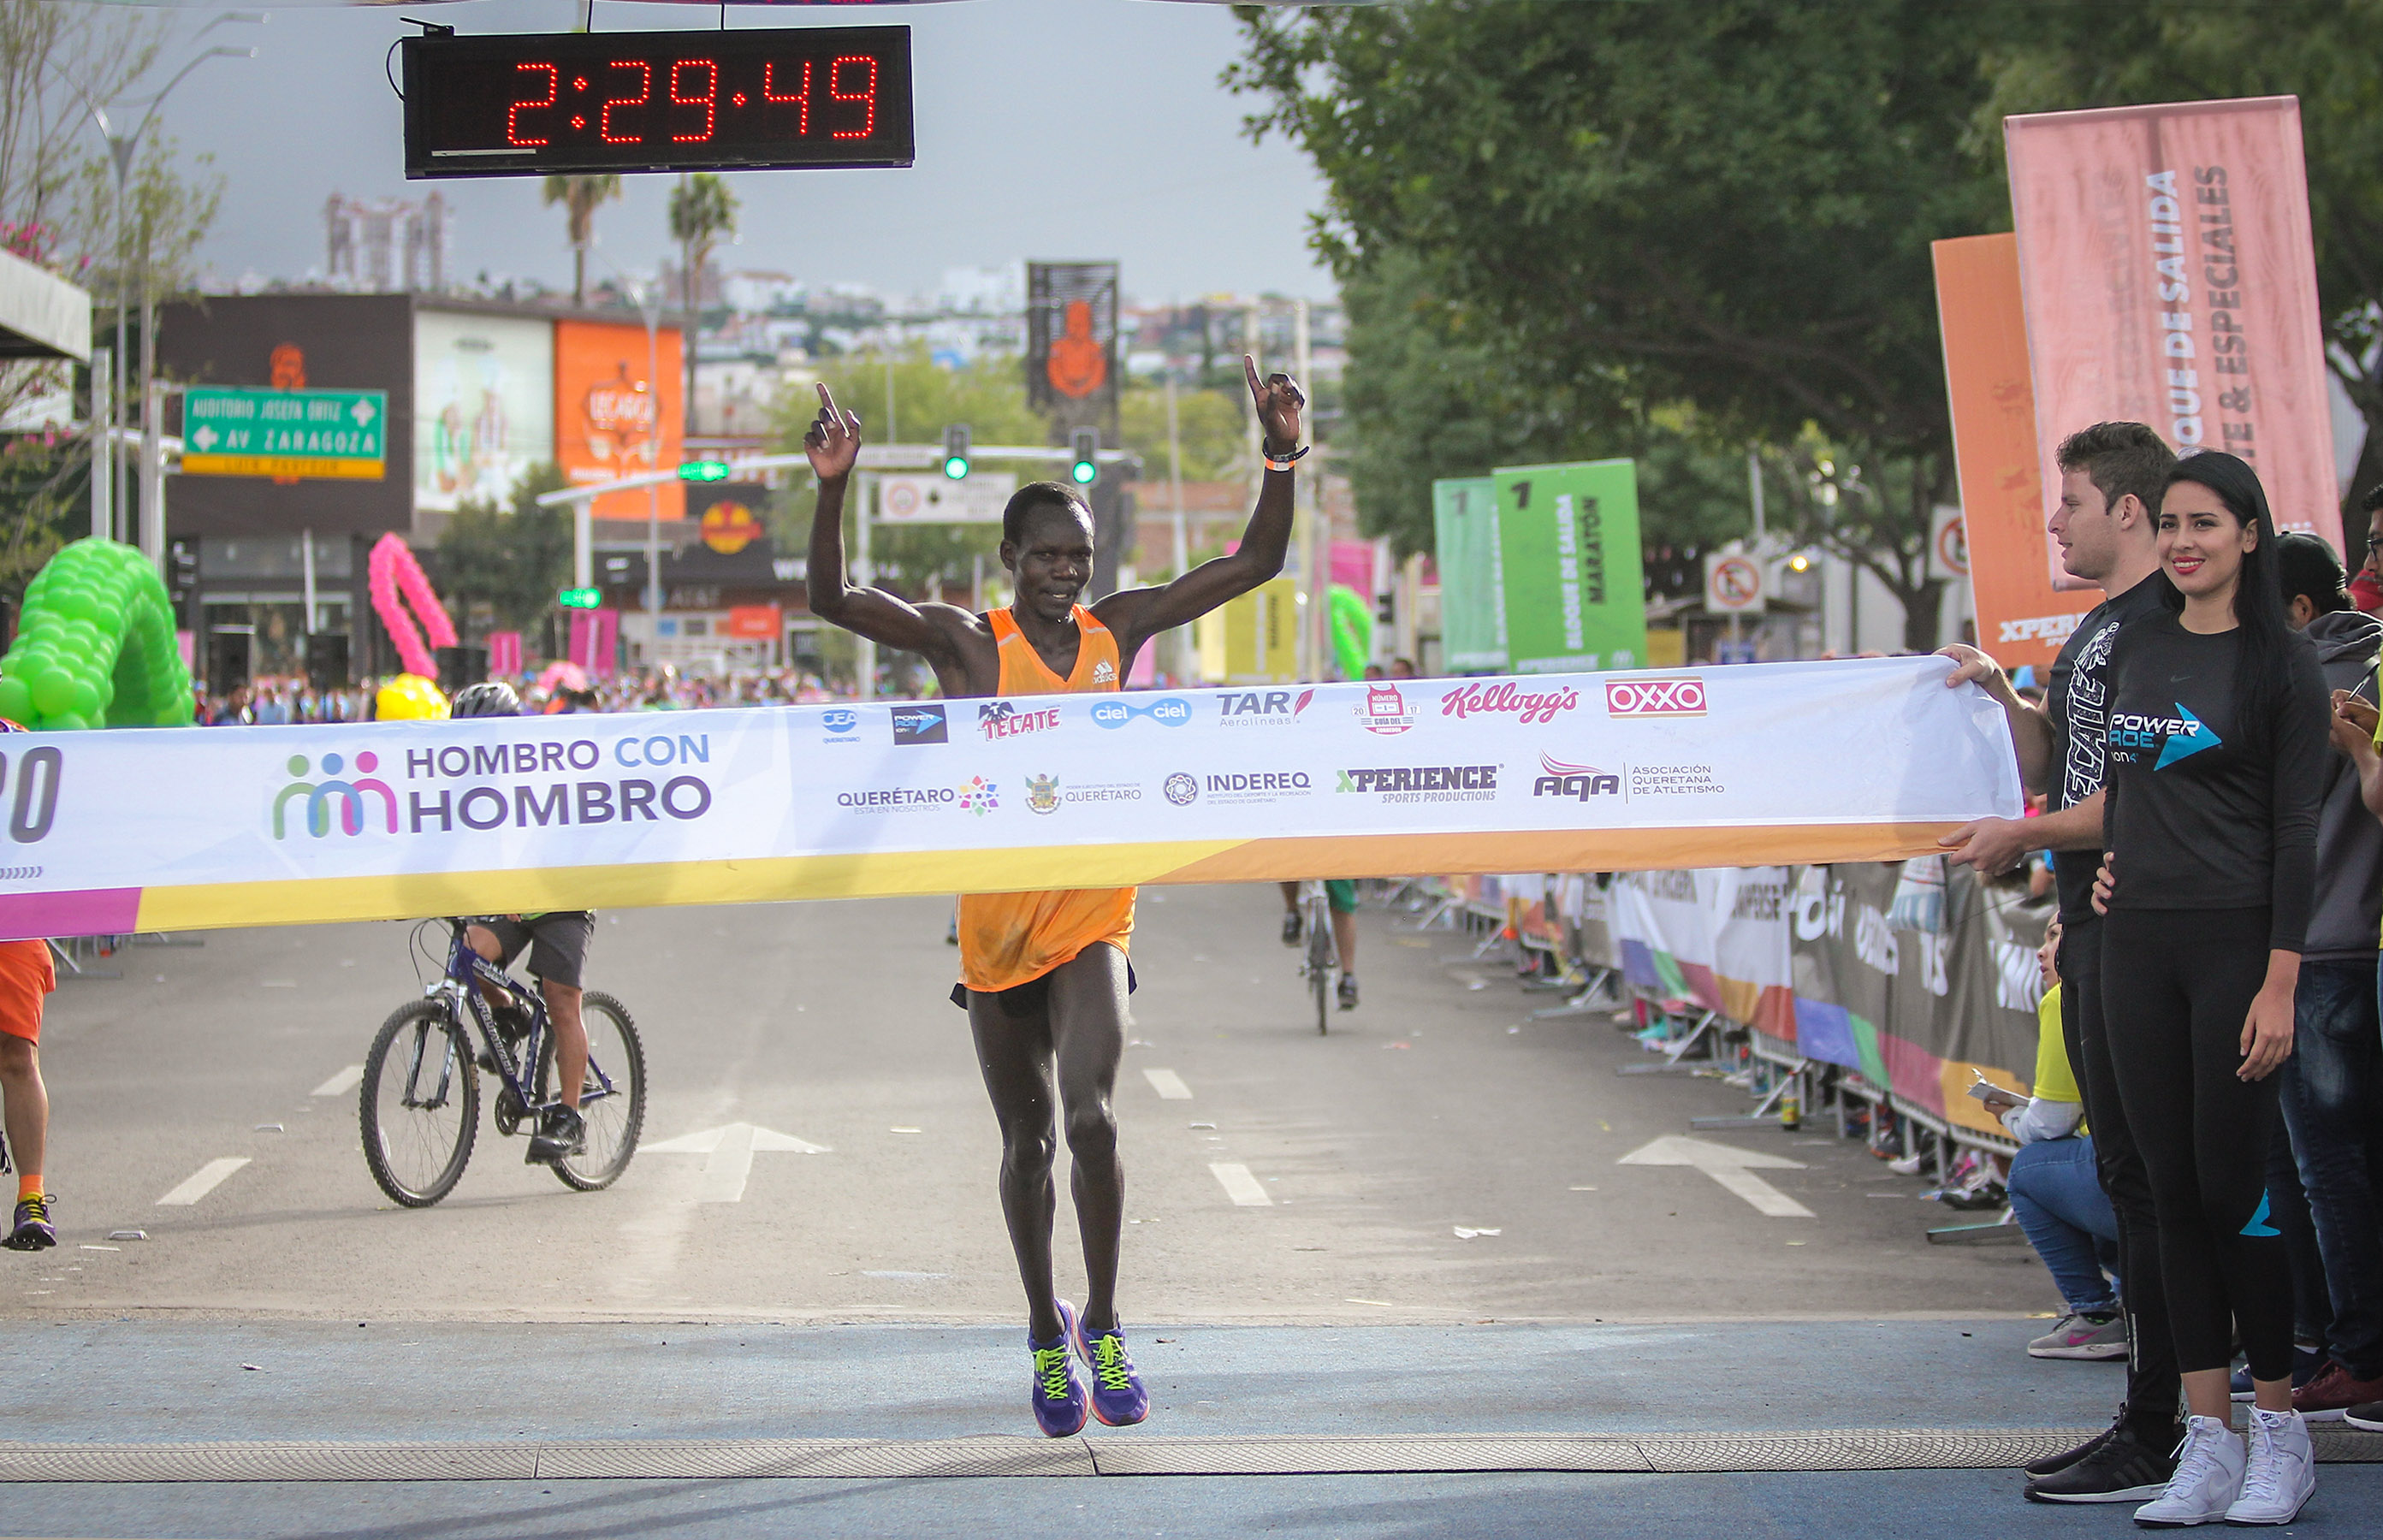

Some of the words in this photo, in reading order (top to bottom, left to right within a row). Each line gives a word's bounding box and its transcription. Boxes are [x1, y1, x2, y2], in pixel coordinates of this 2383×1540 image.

[2146, 170, 2190, 303] SALIDA
[2195, 164, 2248, 375] ESPECIALES
[2162, 312, 2196, 358] DE
[2220, 386, 2252, 414] &
[2167, 369, 2206, 457] QUE
[226, 429, 250, 449] AV
[264, 429, 376, 454] ZARAGOZA
[2222, 424, 2257, 473] TE
[1509, 480, 1532, 511] 1
[1580, 496, 1607, 605] MARATÓN
[1560, 557, 1579, 580] DE
[1216, 691, 1290, 716] TAR
[1372, 694, 1398, 702] NÚMERO
[1441, 681, 1580, 724] Kellogg's
[1609, 682, 1704, 711] OXXO
[821, 713, 856, 726] CEA
[1096, 706, 1128, 720] ciel
[1153, 703, 1186, 718] ciel
[981, 708, 1061, 740] TECATE
[2109, 714, 2200, 737] POWER
[406, 740, 600, 779] HOMBRO
[614, 734, 710, 768] CON
[1206, 772, 1312, 791] INDEREQ
[1336, 766, 1497, 792] XPERIENCE
[1633, 764, 1711, 775] ASOCIACIÓN
[1633, 776, 1712, 785] QUERETANA
[838, 787, 954, 807] QUERÉTARO
[1065, 789, 1141, 802] QUERÉTARO
[1382, 792, 1420, 803] SPORTS
[1424, 791, 1496, 803] PRODUCTIONS
[1653, 785, 1725, 794] ATLETISMO
[409, 775, 712, 834] HOMBRO
[892, 803, 941, 813] NOSOTROS
